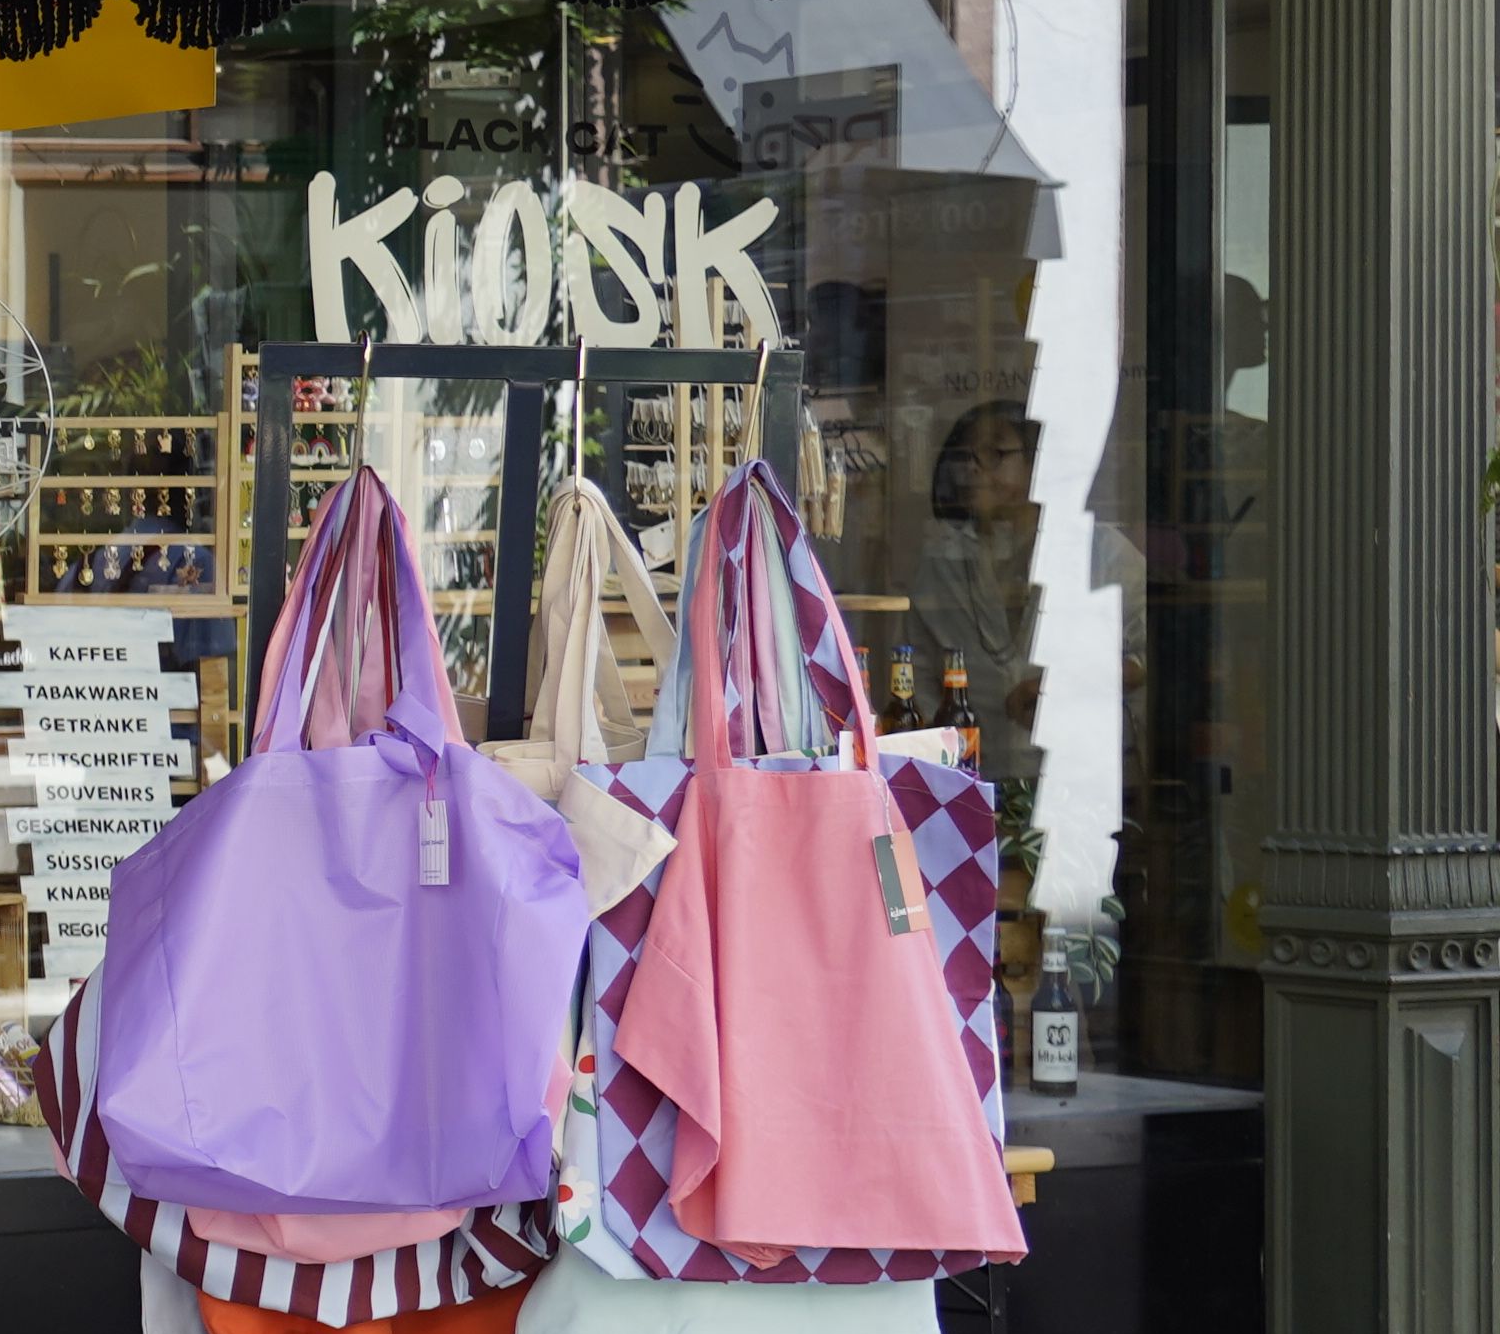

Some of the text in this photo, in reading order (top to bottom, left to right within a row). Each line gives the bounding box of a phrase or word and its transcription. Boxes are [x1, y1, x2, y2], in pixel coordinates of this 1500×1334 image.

[383, 116, 669, 159] BLACK CAT
[49, 646, 128, 662] KAFFEE
[23, 684, 159, 701] TABAKWAREN
[38, 713, 148, 733] GETRÄNKE
[25, 752, 179, 768] ZEITSCHRIFTEN
[45, 785, 155, 802] SOUVENIRS
